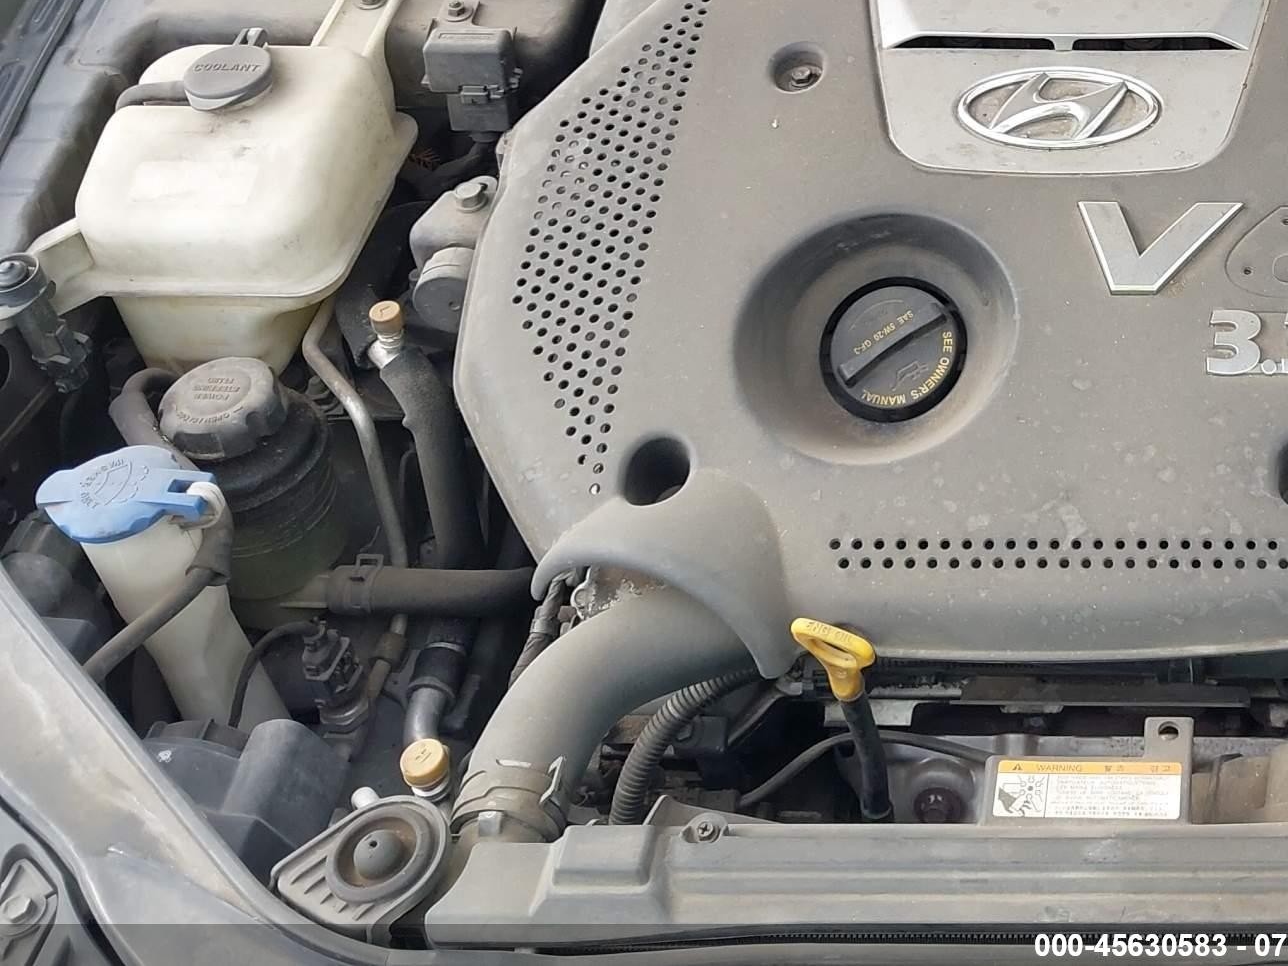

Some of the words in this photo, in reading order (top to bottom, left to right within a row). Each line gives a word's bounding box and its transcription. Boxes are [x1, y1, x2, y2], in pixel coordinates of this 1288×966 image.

[194, 63, 261, 72] COOLANT
[896, 309, 914, 325] SAE
[942, 330, 953, 354] SEE
[909, 356, 951, 400] OWNER'S
[861, 389, 907, 406] MANUAL
[1036, 763, 1082, 772] WARNING
